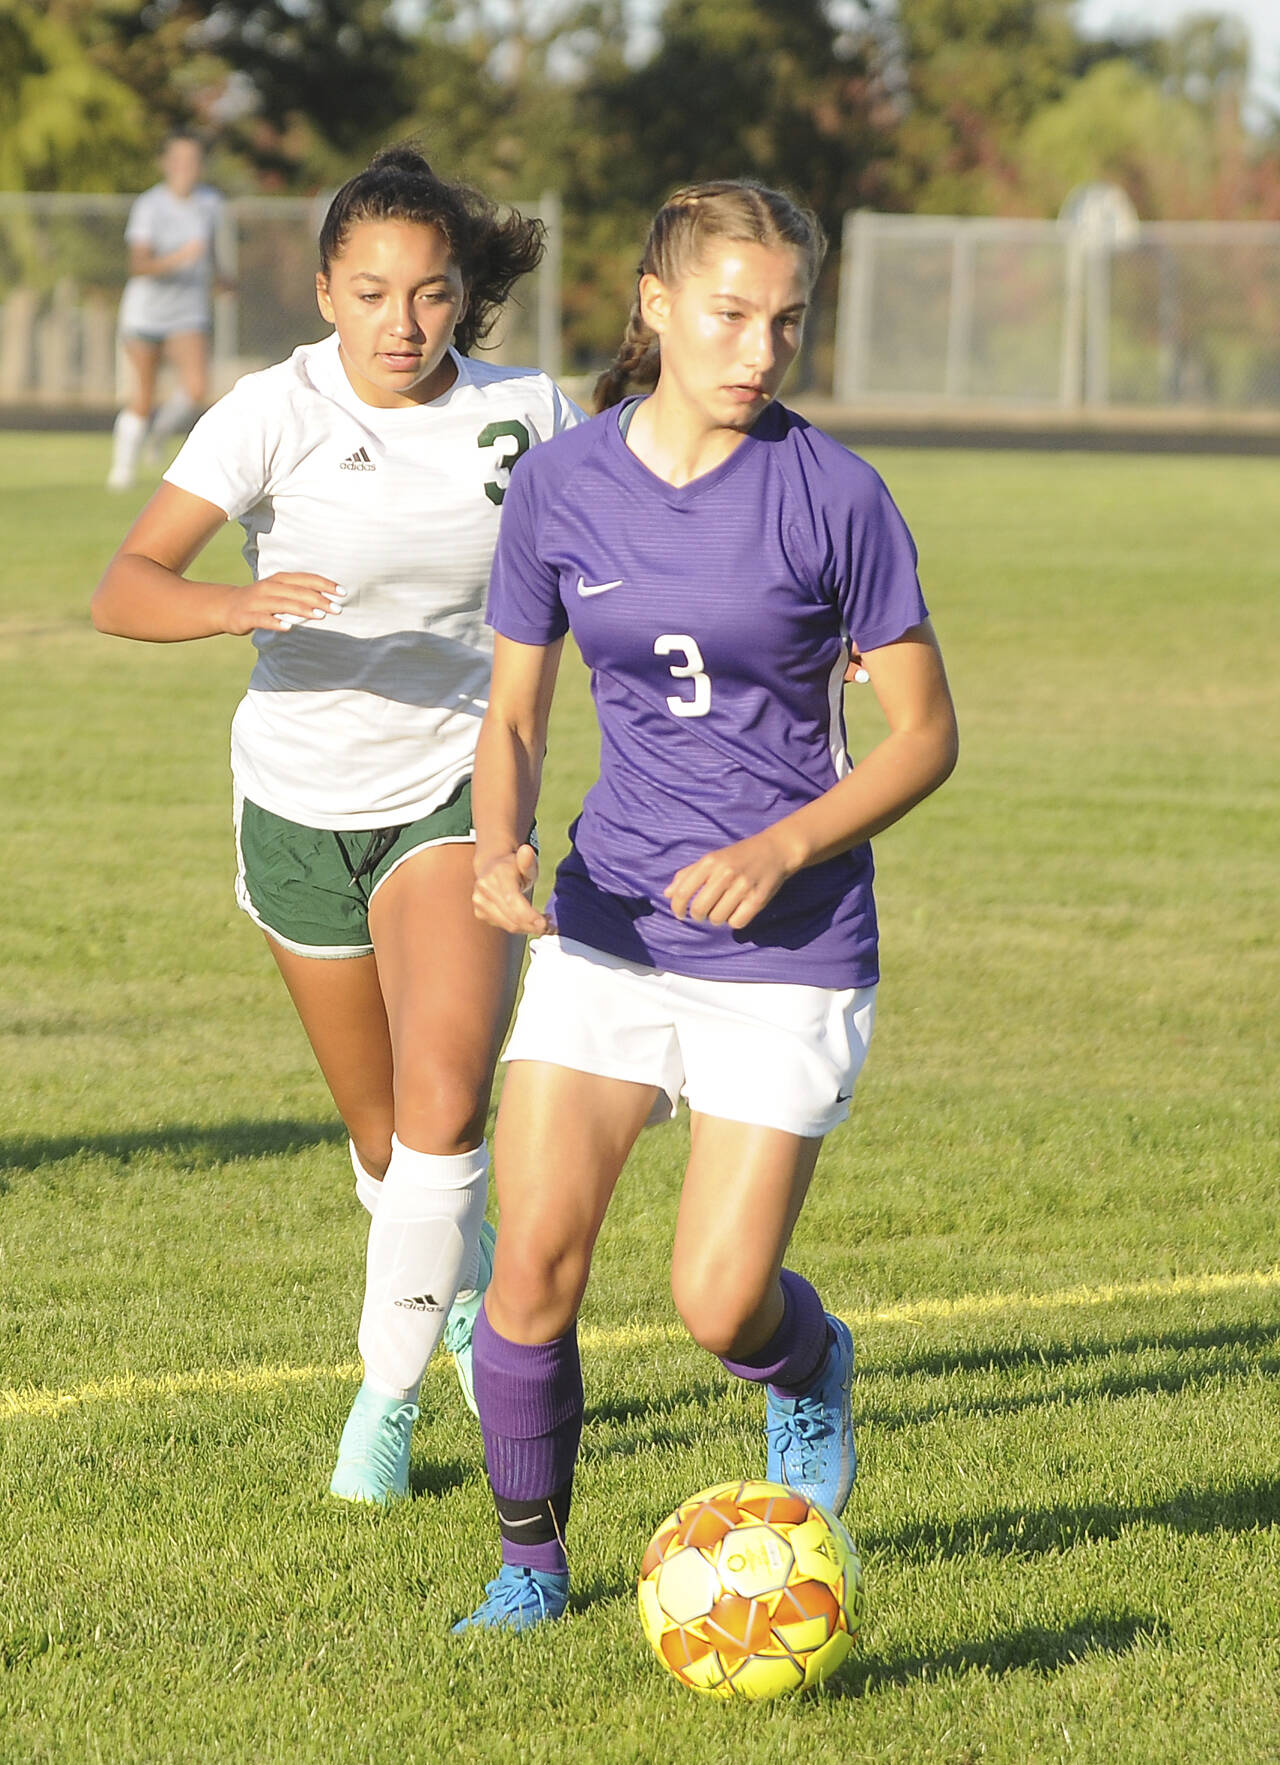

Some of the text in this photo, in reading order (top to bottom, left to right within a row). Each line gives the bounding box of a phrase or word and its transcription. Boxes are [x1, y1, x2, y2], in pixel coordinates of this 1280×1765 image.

[339, 461, 376, 472] adidas
[477, 419, 530, 506] 3
[653, 633, 712, 718] 3
